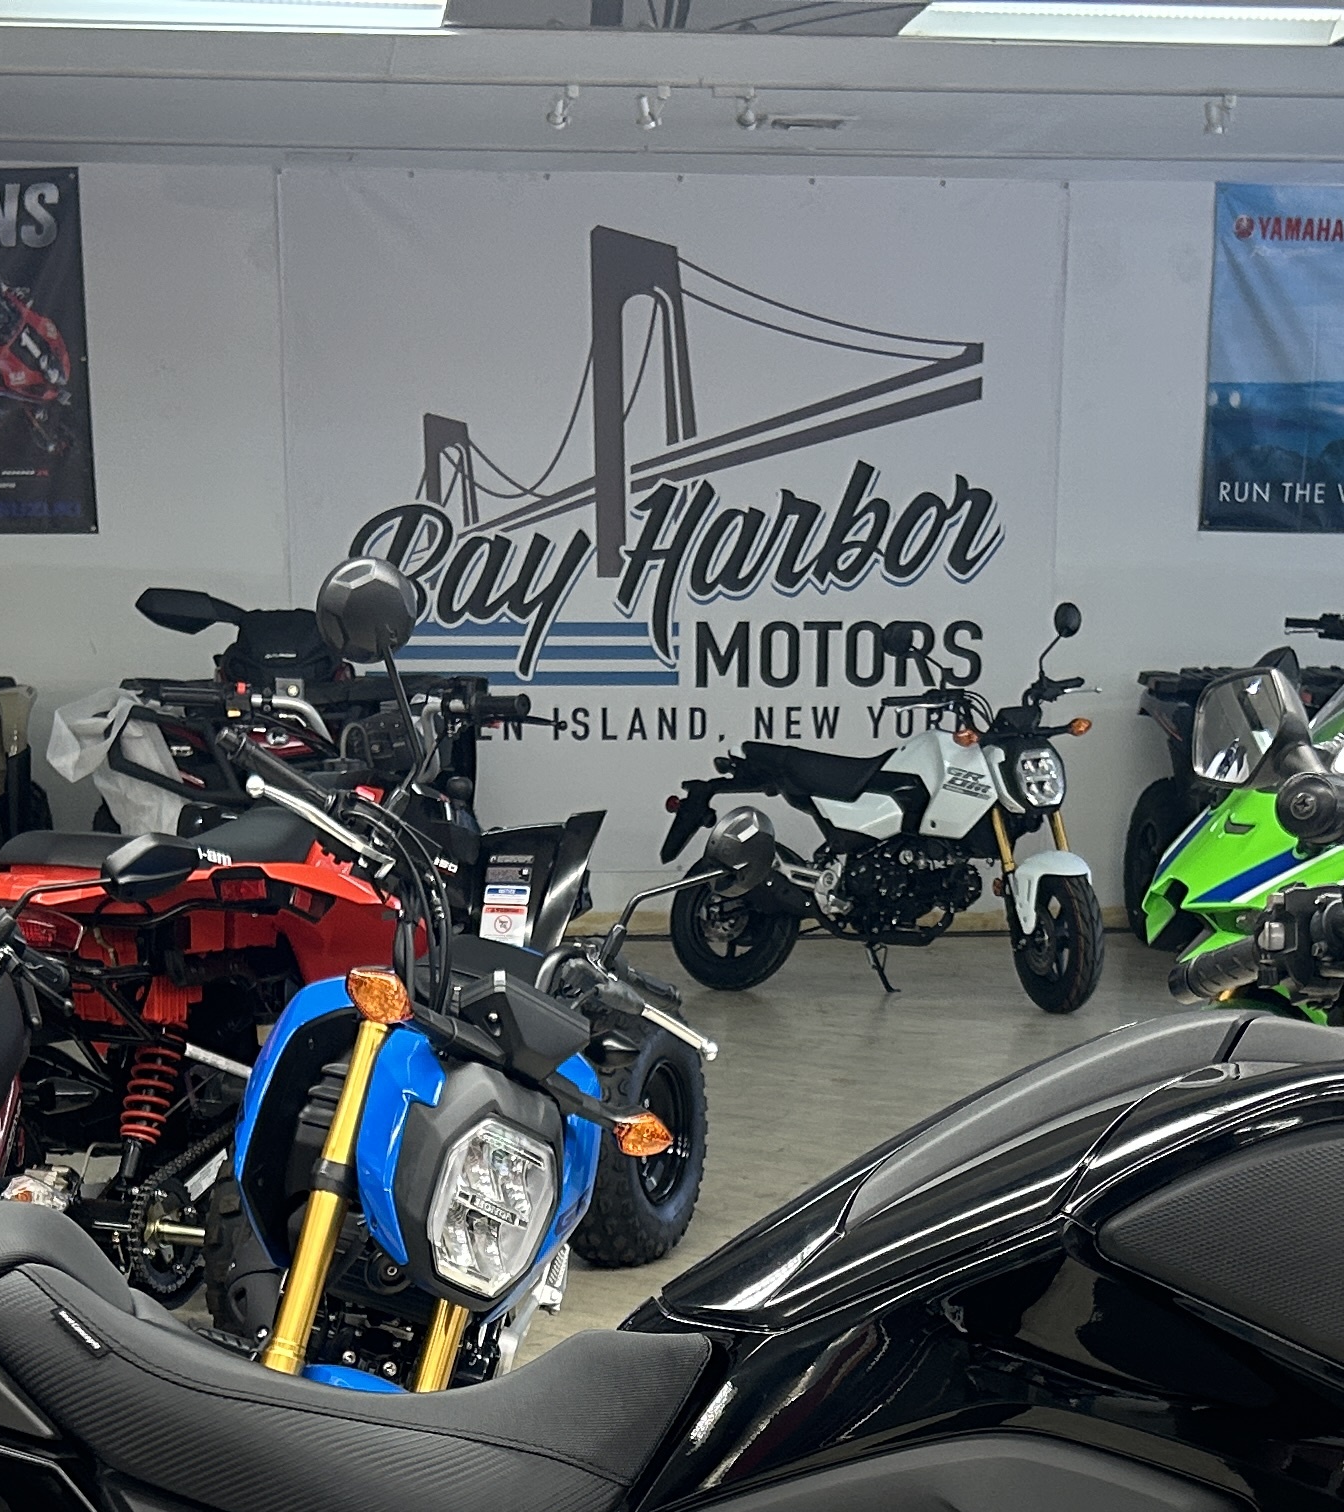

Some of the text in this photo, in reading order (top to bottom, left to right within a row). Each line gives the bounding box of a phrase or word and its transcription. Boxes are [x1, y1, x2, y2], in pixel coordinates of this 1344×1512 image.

[1258, 216, 1344, 242] YAMAHA
[1218, 481, 1270, 503] RUN
[1281, 481, 1326, 504] THE
[348, 458, 1006, 680] Bay Harbor
[694, 619, 984, 689] MOTORS
[552, 706, 726, 745] ISLAND,
[753, 705, 854, 741] NEW
